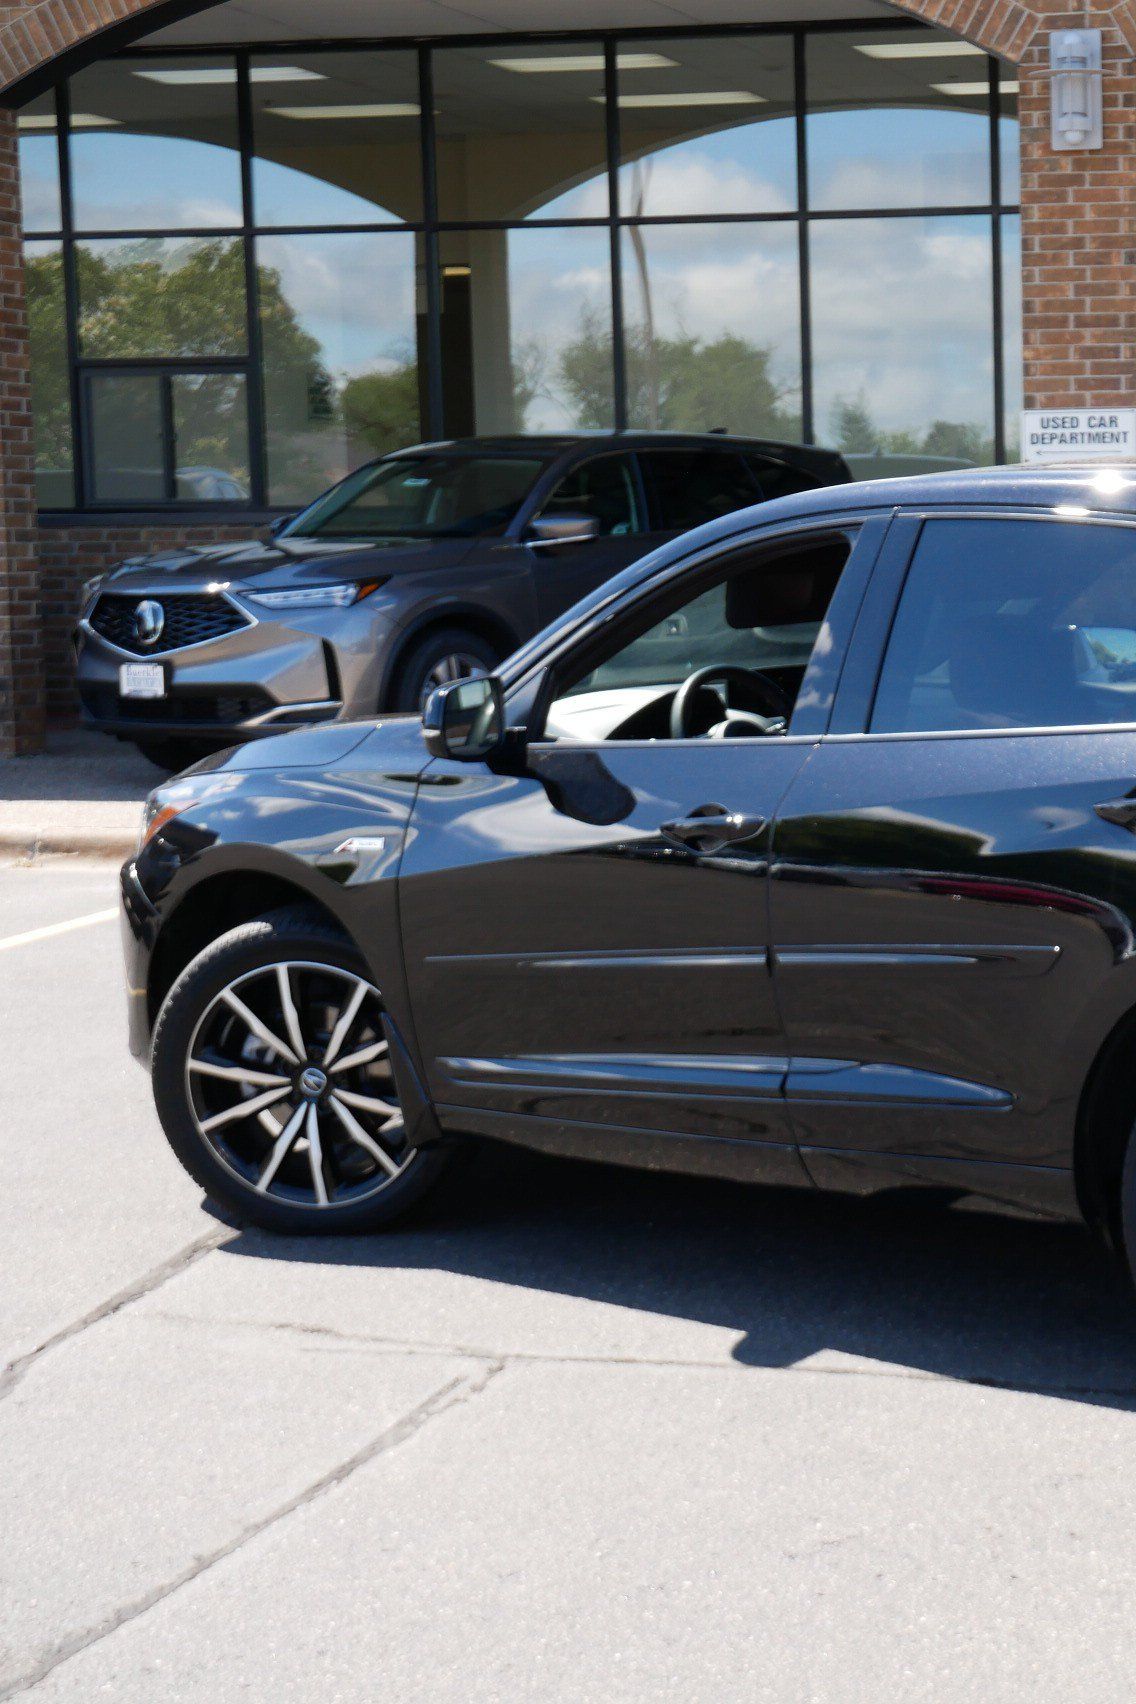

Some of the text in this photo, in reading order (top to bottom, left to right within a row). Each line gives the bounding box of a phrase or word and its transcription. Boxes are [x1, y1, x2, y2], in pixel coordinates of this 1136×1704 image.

[1040, 415, 1119, 429] USED CAR
[1030, 431, 1129, 445] DEPARTMENT
